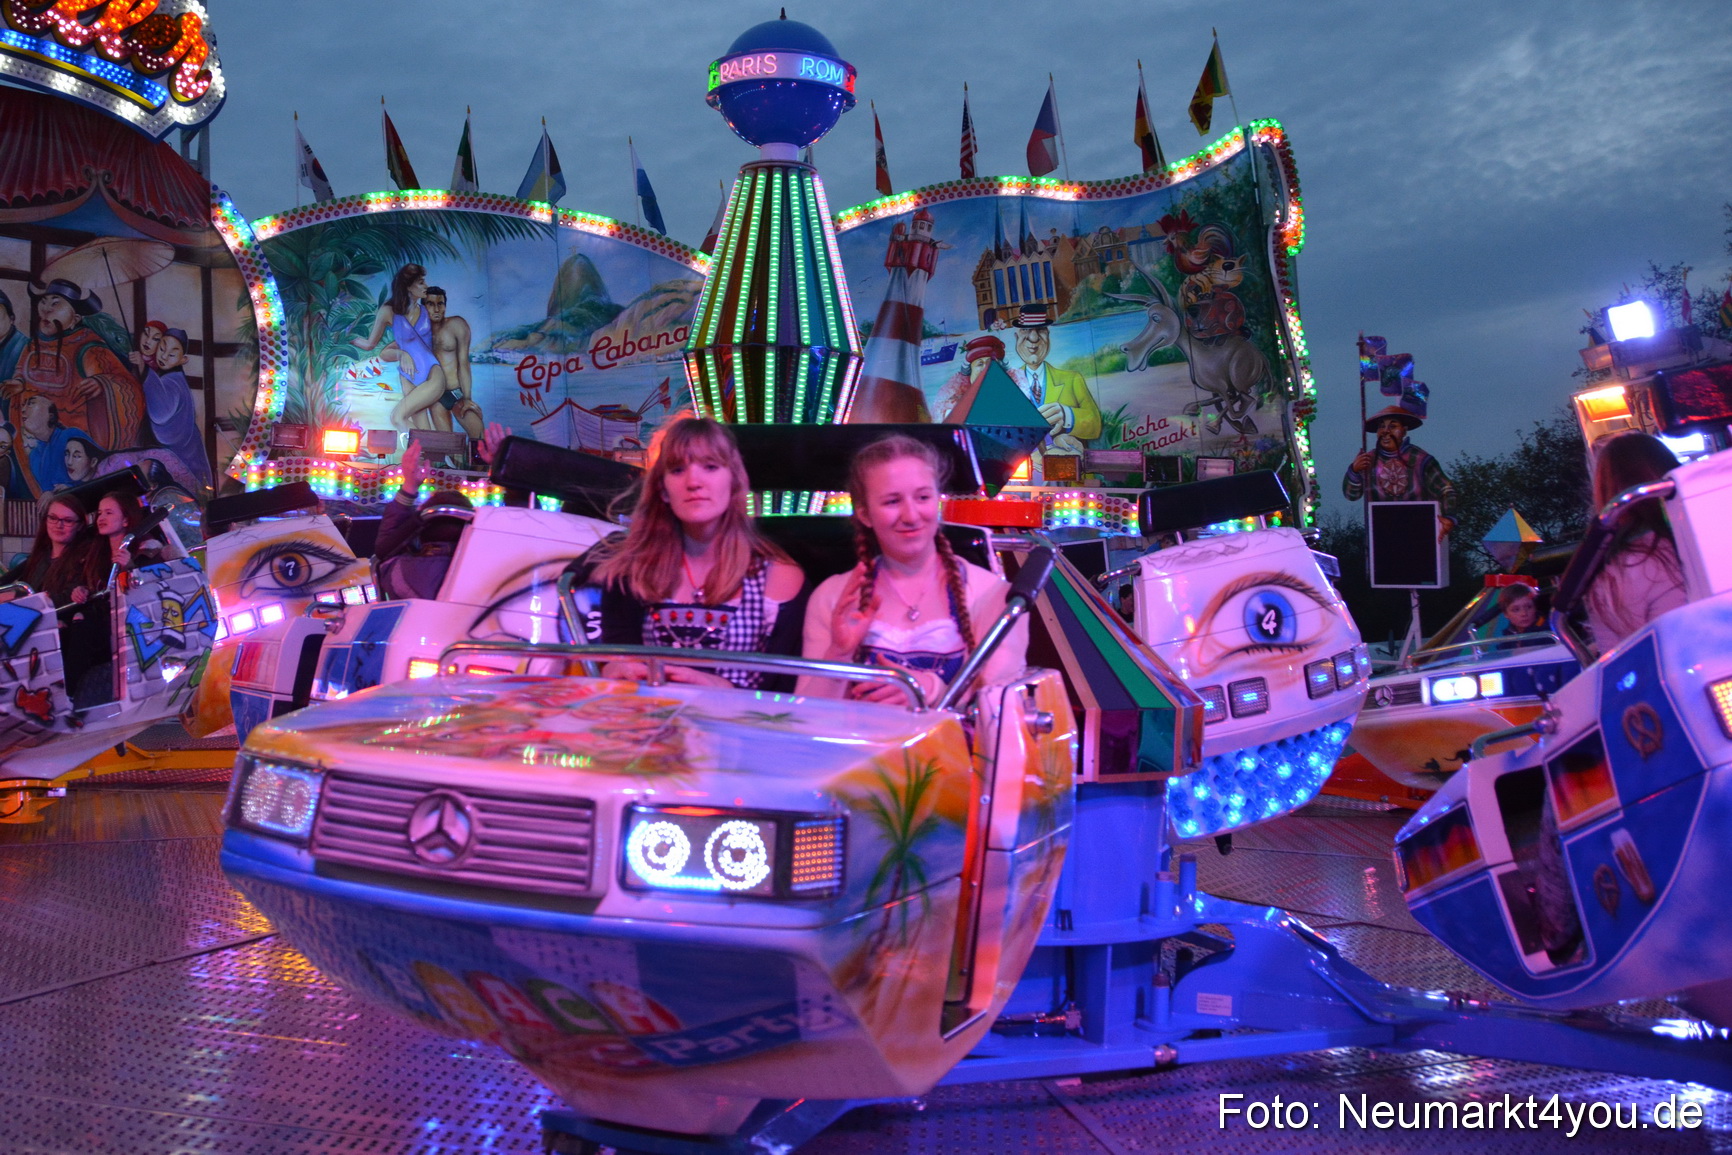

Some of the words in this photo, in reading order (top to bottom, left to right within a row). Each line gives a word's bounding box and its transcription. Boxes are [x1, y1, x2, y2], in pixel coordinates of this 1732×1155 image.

[720, 53, 778, 82] PARIS
[800, 57, 845, 85] ROM
[514, 355, 583, 393] Copa
[588, 325, 690, 370] Cabana
[1261, 609, 1277, 635] 4
